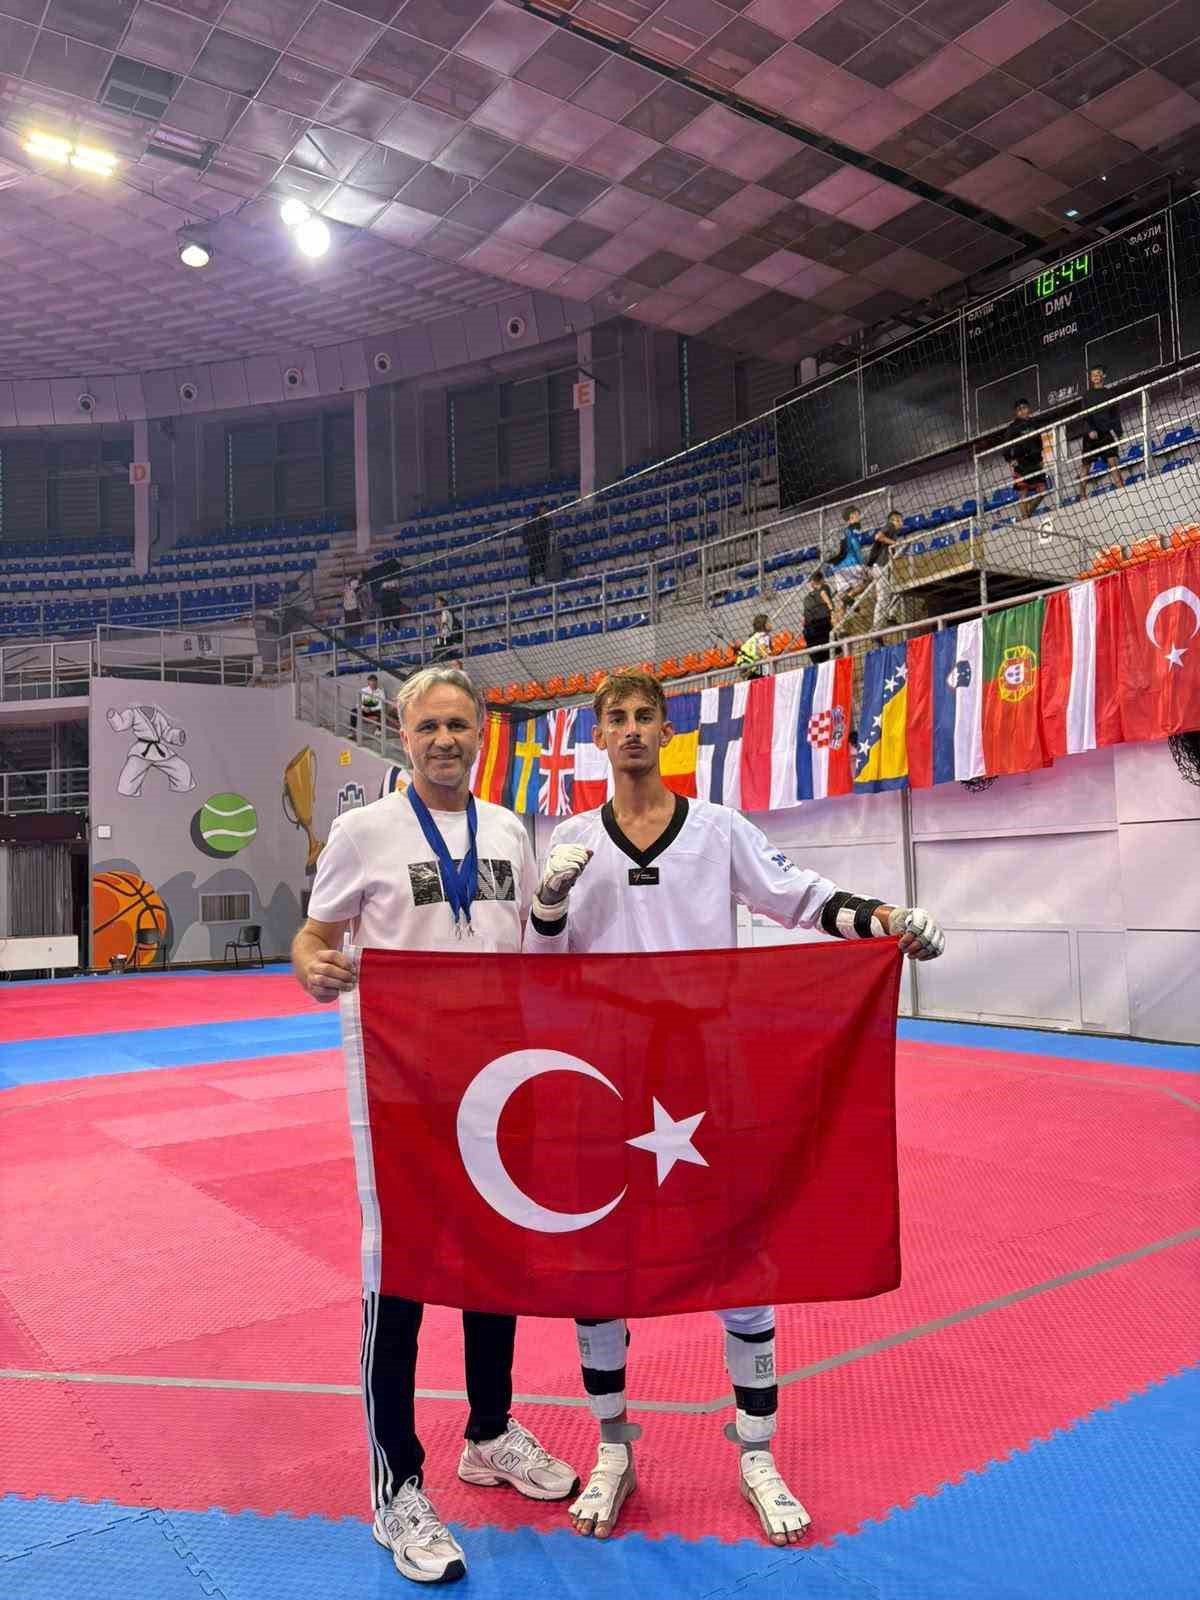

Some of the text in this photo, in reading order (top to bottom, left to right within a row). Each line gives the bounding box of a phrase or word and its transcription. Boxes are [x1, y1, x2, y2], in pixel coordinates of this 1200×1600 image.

[1036, 254, 1088, 297] 18:44
[1045, 291, 1073, 316] DMV
[1042, 322, 1079, 345] ПЕРИОД
[579, 384, 591, 404] E
[134, 464, 146, 481] D
